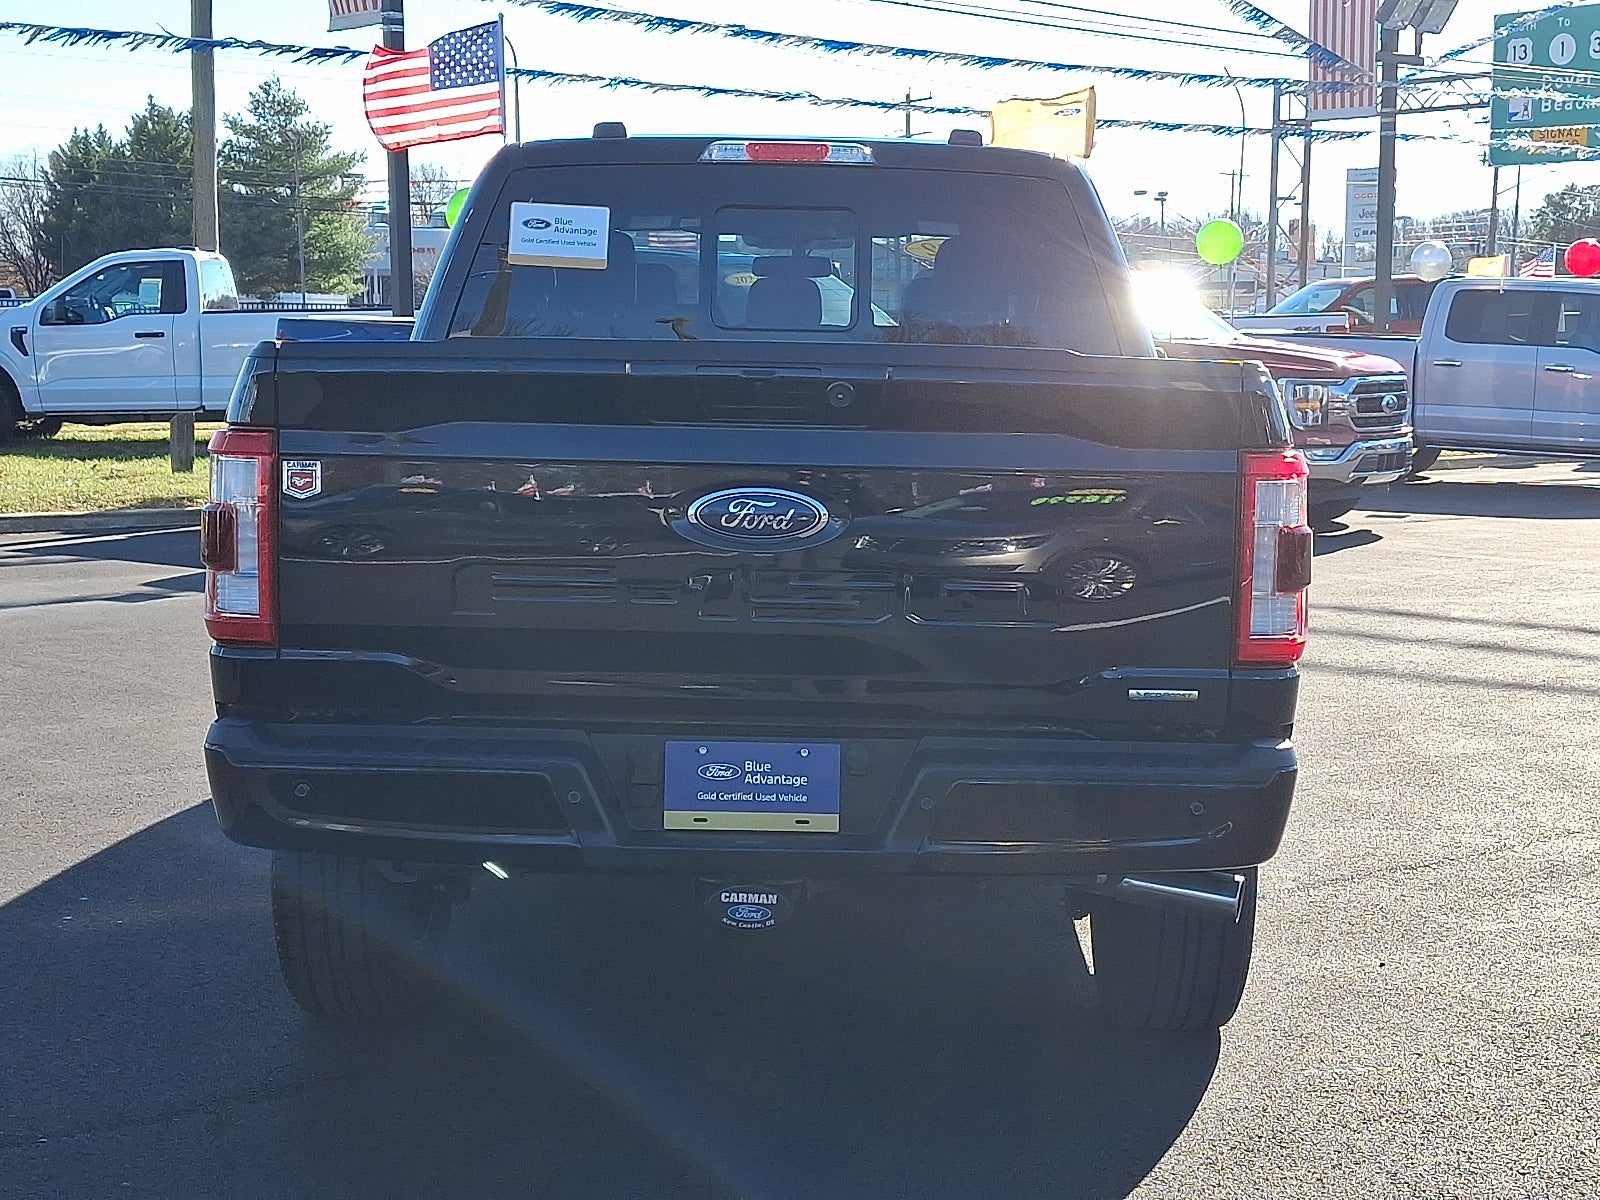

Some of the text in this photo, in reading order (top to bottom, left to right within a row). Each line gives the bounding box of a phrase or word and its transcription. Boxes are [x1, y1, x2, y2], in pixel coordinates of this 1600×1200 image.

[1512, 44, 1528, 61] 13
[1560, 41, 1565, 57] 1
[1539, 128, 1581, 139] SIGNAL
[1359, 208, 1377, 219] Jee
[554, 217, 573, 225] Blue
[553, 226, 598, 237] Advantage
[719, 498, 796, 530] Ford
[703, 765, 736, 778] Ford
[745, 760, 772, 772] Blue
[744, 773, 808, 787] Advantage
[697, 791, 808, 803] Gold Certified Used Vehicle
[720, 892, 778, 904] CARMAN
[733, 906, 766, 919] Ford
[722, 917, 738, 926] New
